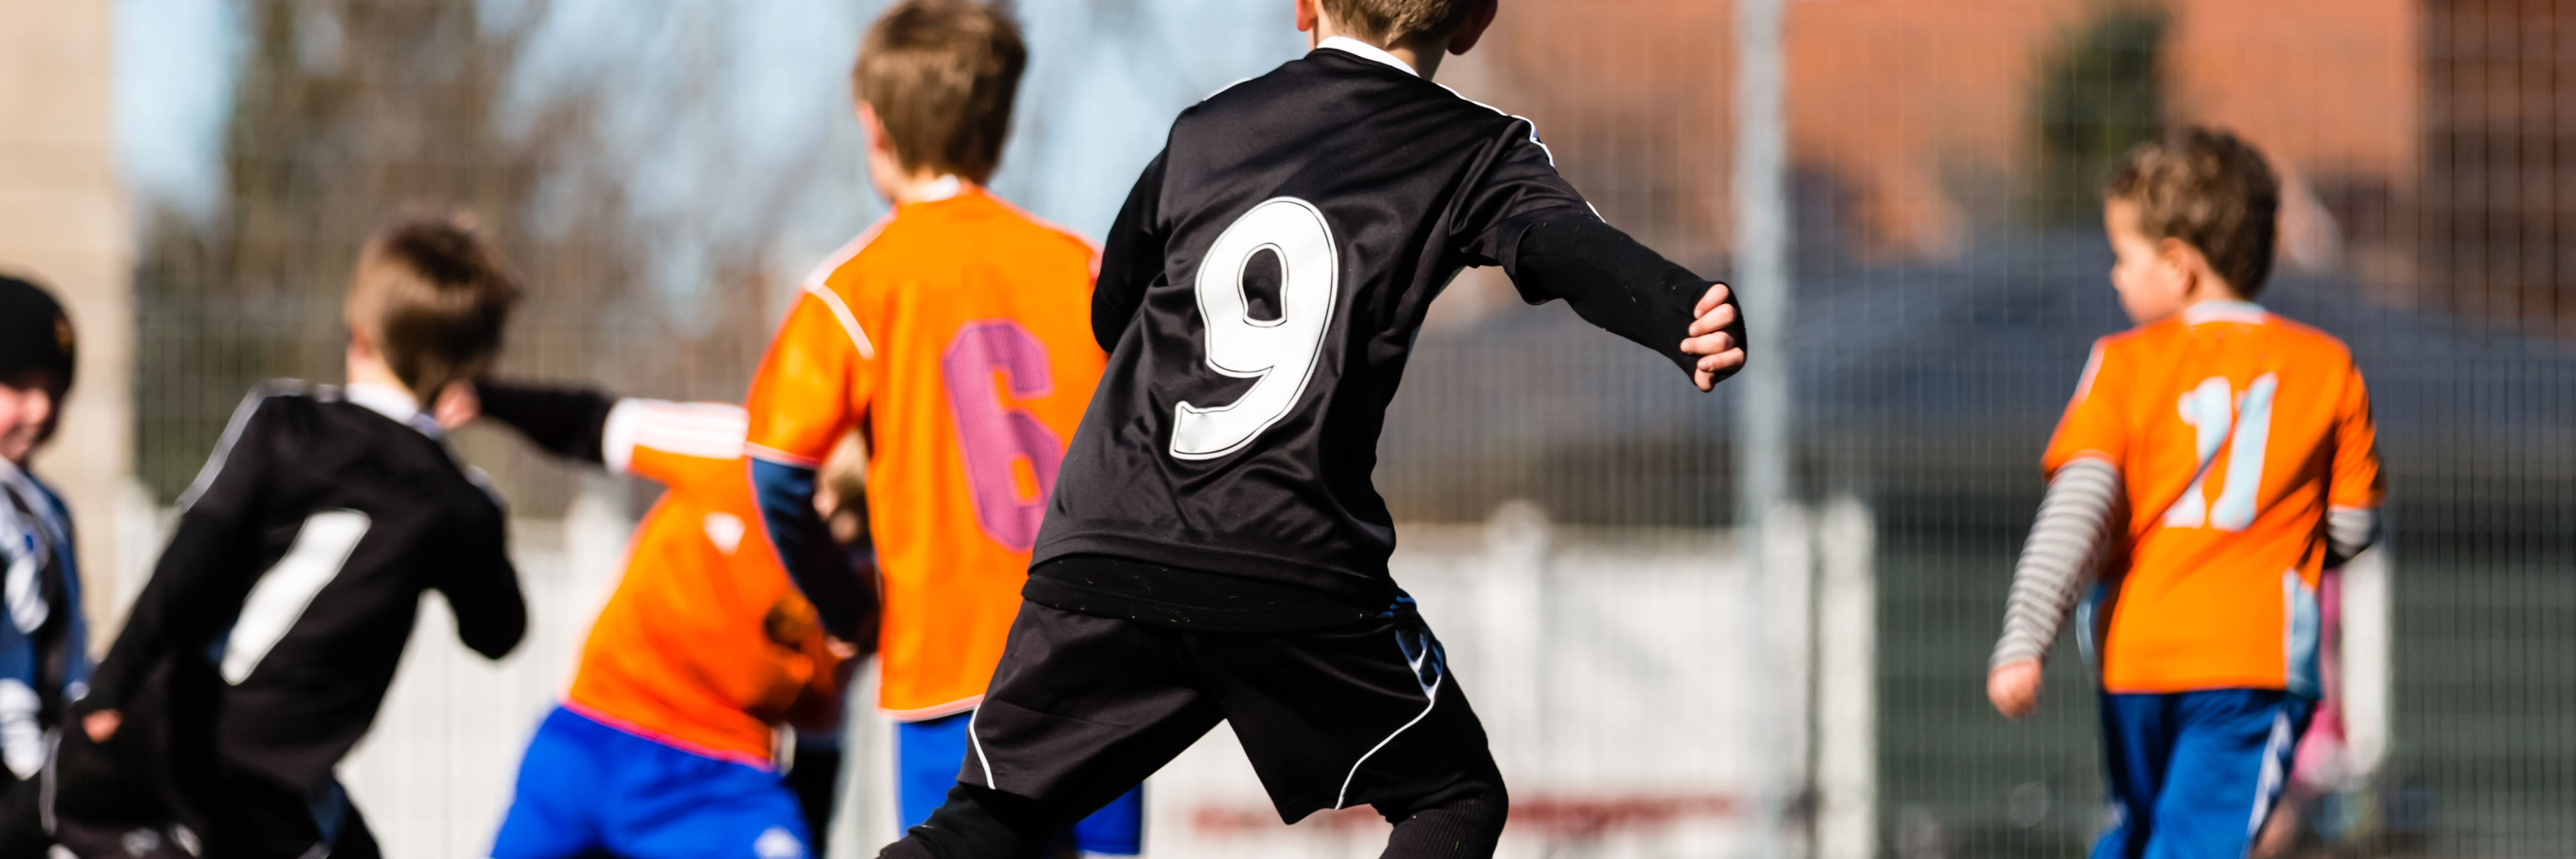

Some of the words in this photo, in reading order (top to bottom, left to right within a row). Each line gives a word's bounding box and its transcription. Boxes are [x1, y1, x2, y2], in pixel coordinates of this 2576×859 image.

[941, 317, 1065, 554] 6
[1169, 196, 1339, 460] 9
[2161, 370, 2279, 533] 11
